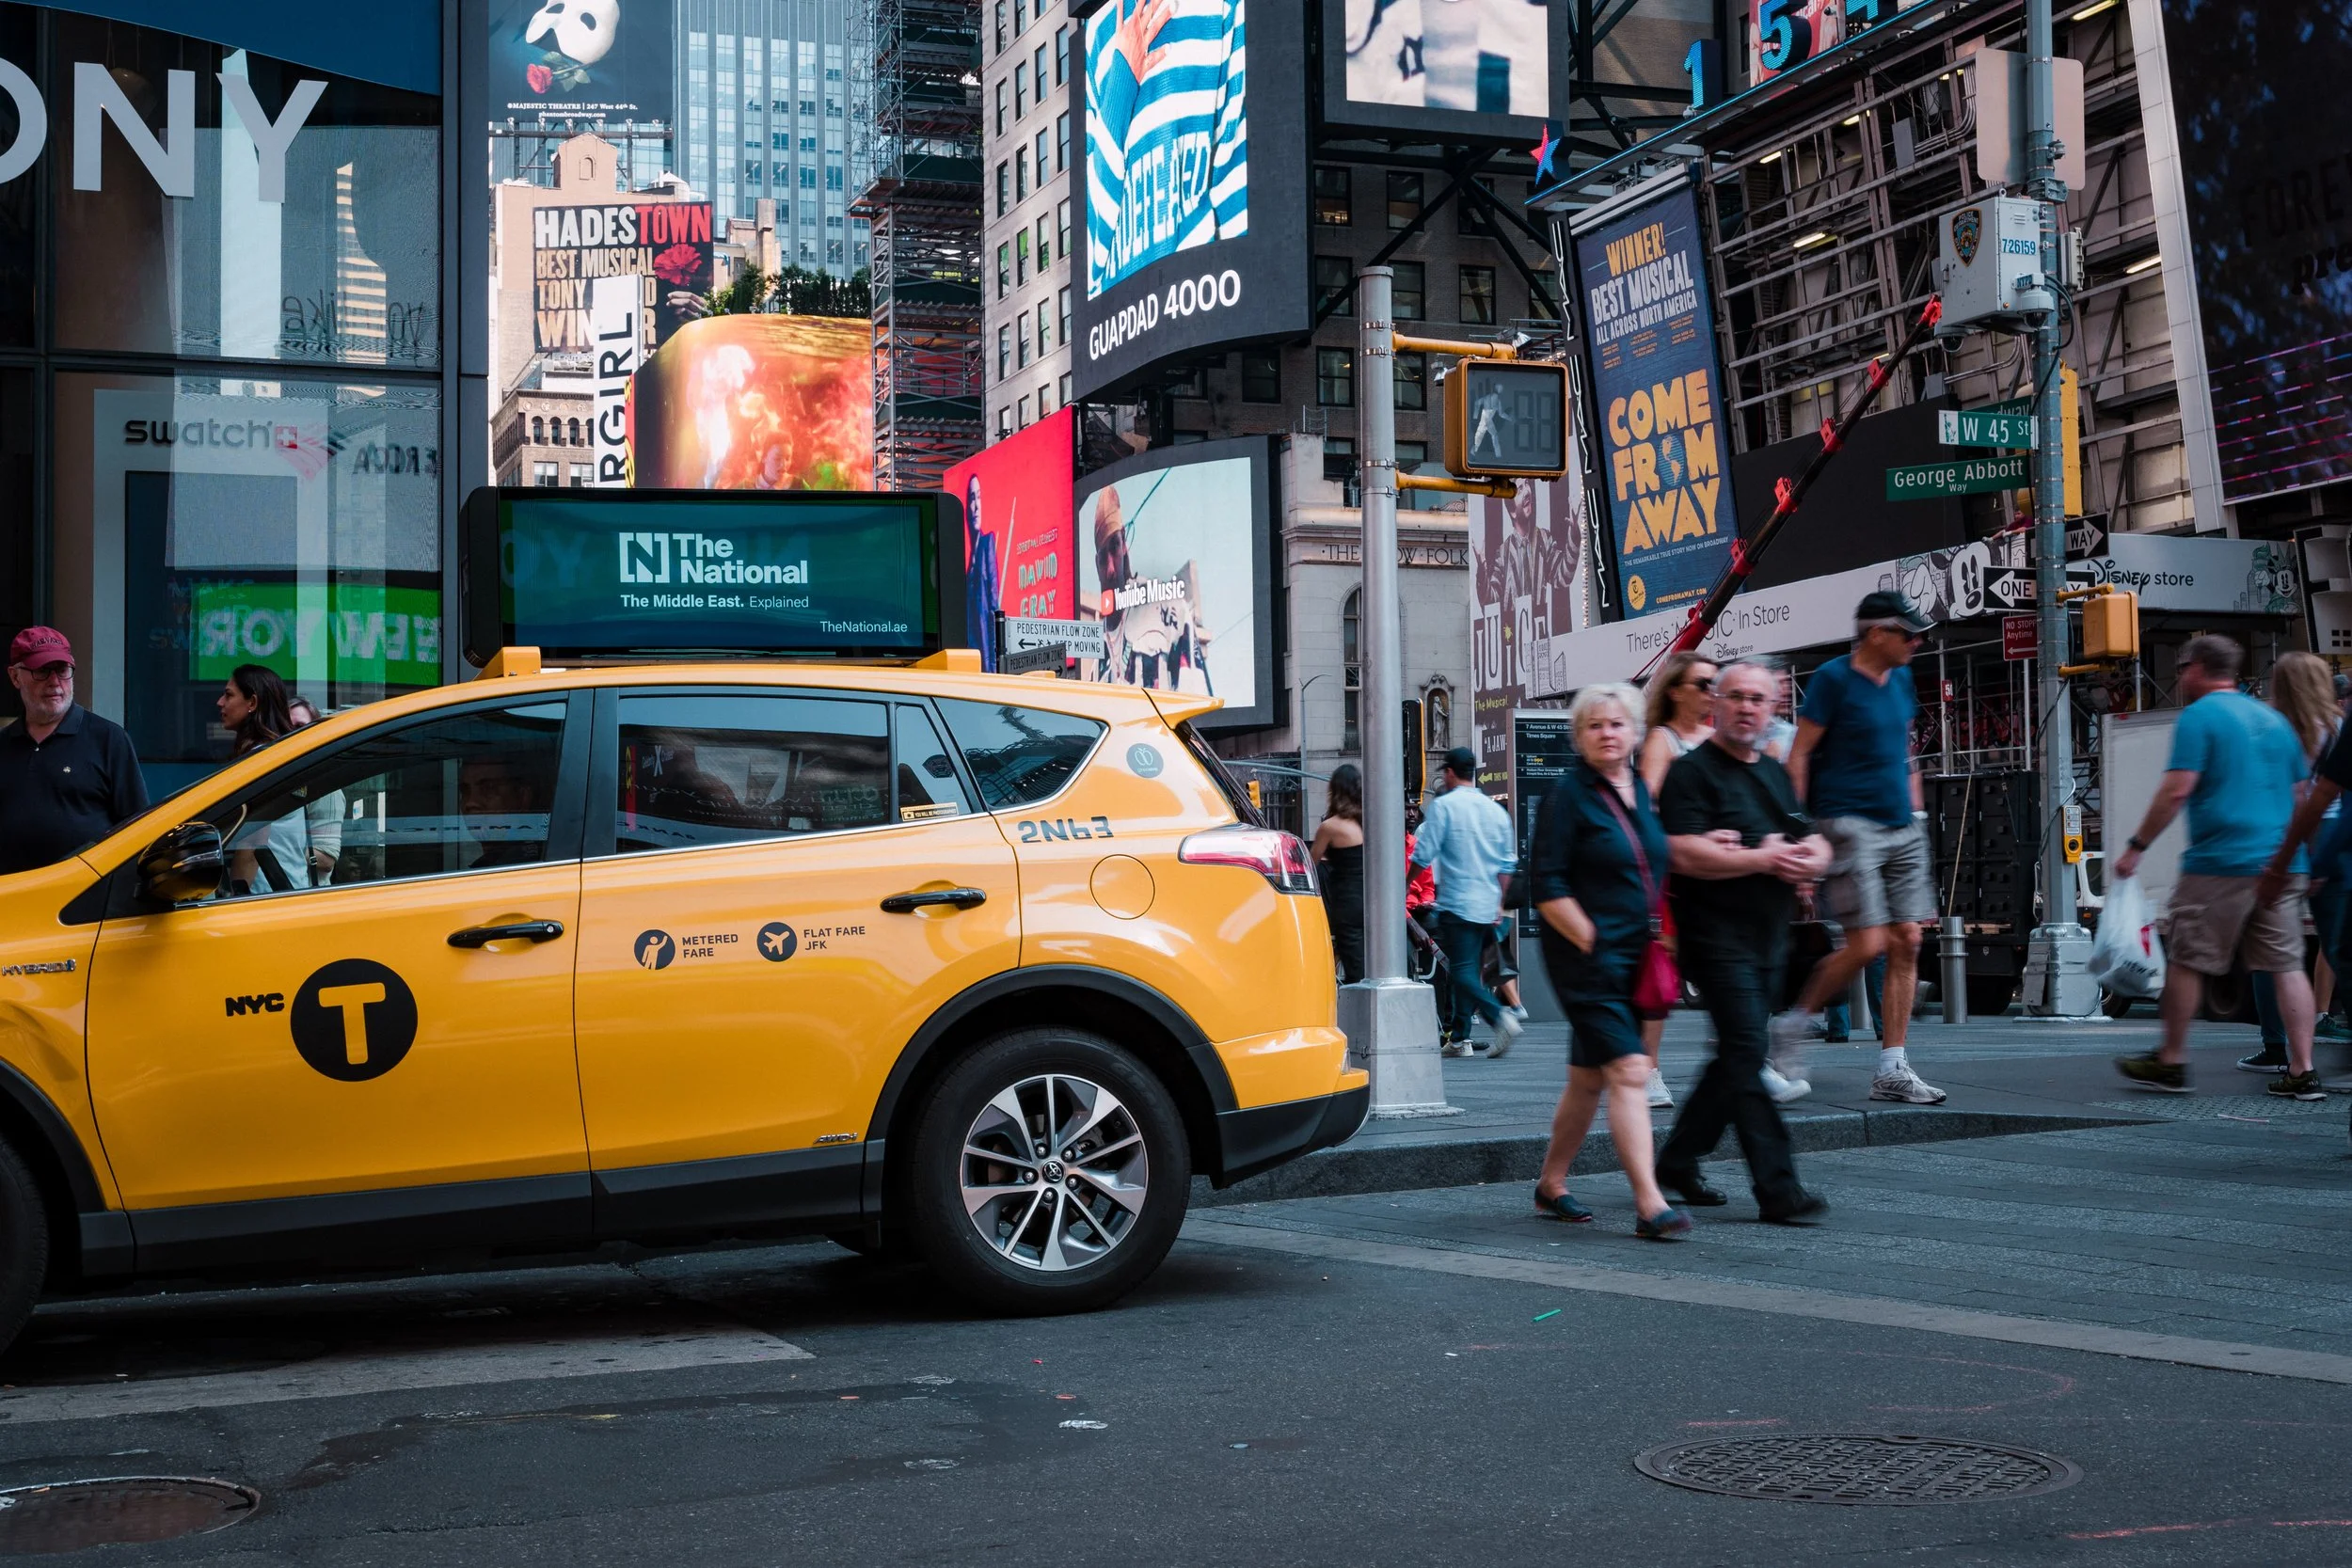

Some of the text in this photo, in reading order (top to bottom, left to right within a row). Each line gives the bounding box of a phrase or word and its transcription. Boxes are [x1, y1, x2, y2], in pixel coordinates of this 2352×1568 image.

[534, 205, 712, 248] HADESTOWN
[1605, 221, 1667, 277] WINNER!
[2002, 239, 2036, 255] 726159
[536, 246, 656, 279] BEST MUSICAL
[537, 278, 588, 309] TONY
[1591, 250, 1694, 325] BEST MUSICAL
[1089, 269, 1242, 361] GUAPDAD 4000
[1596, 324, 1611, 346] ALL
[1610, 311, 1639, 341] ACROSS
[1640, 299, 1663, 329] NORTH
[1663, 290, 1698, 320] AMERICA
[537, 308, 657, 348] WINR
[1608, 368, 1712, 448] COME
[124, 416, 273, 448] swatch
[1963, 418, 2029, 443] W 45 St
[1894, 458, 2024, 488] George Abbott
[1948, 483, 1967, 494] Way
[1622, 477, 1722, 555] AWAY
[673, 532, 734, 558] The
[2070, 529, 2095, 549] WAY
[1326, 544, 1359, 561] THE
[1624, 559, 1633, 567] THE
[1632, 553, 1661, 566] REMARKABLE
[1671, 546, 1685, 555] STORY
[1685, 544, 1696, 552] NOW
[1704, 536, 1728, 547] BROADWAY
[680, 561, 808, 584] National
[2154, 571, 2194, 587] store
[1114, 575, 1185, 611] YouTube Music
[2000, 580, 2032, 597] ONE
[620, 594, 809, 610] The Middle East. Explained
[819, 621, 908, 633] TheNational.ae
[1017, 622, 1100, 639] PEDESTRIAN FLOW ZONE
[1626, 626, 1669, 654] There's
[1740, 610, 1751, 629] In
[1753, 604, 1790, 626] Store
[2006, 622, 2015, 630] NO
[2006, 630, 2033, 641] Anytime
[1009, 647, 1064, 671] PEDESTRIAN FLOW ZONE
[1073, 641, 1101, 654] MOVING
[1739, 644, 1754, 654] store
[1475, 700, 1486, 713] The
[682, 934, 739, 946] METERED
[803, 926, 866, 939] FLAT FARE
[683, 947, 714, 958] FARE
[804, 941, 827, 951] JFK
[225, 982, 386, 1065] NYC T
